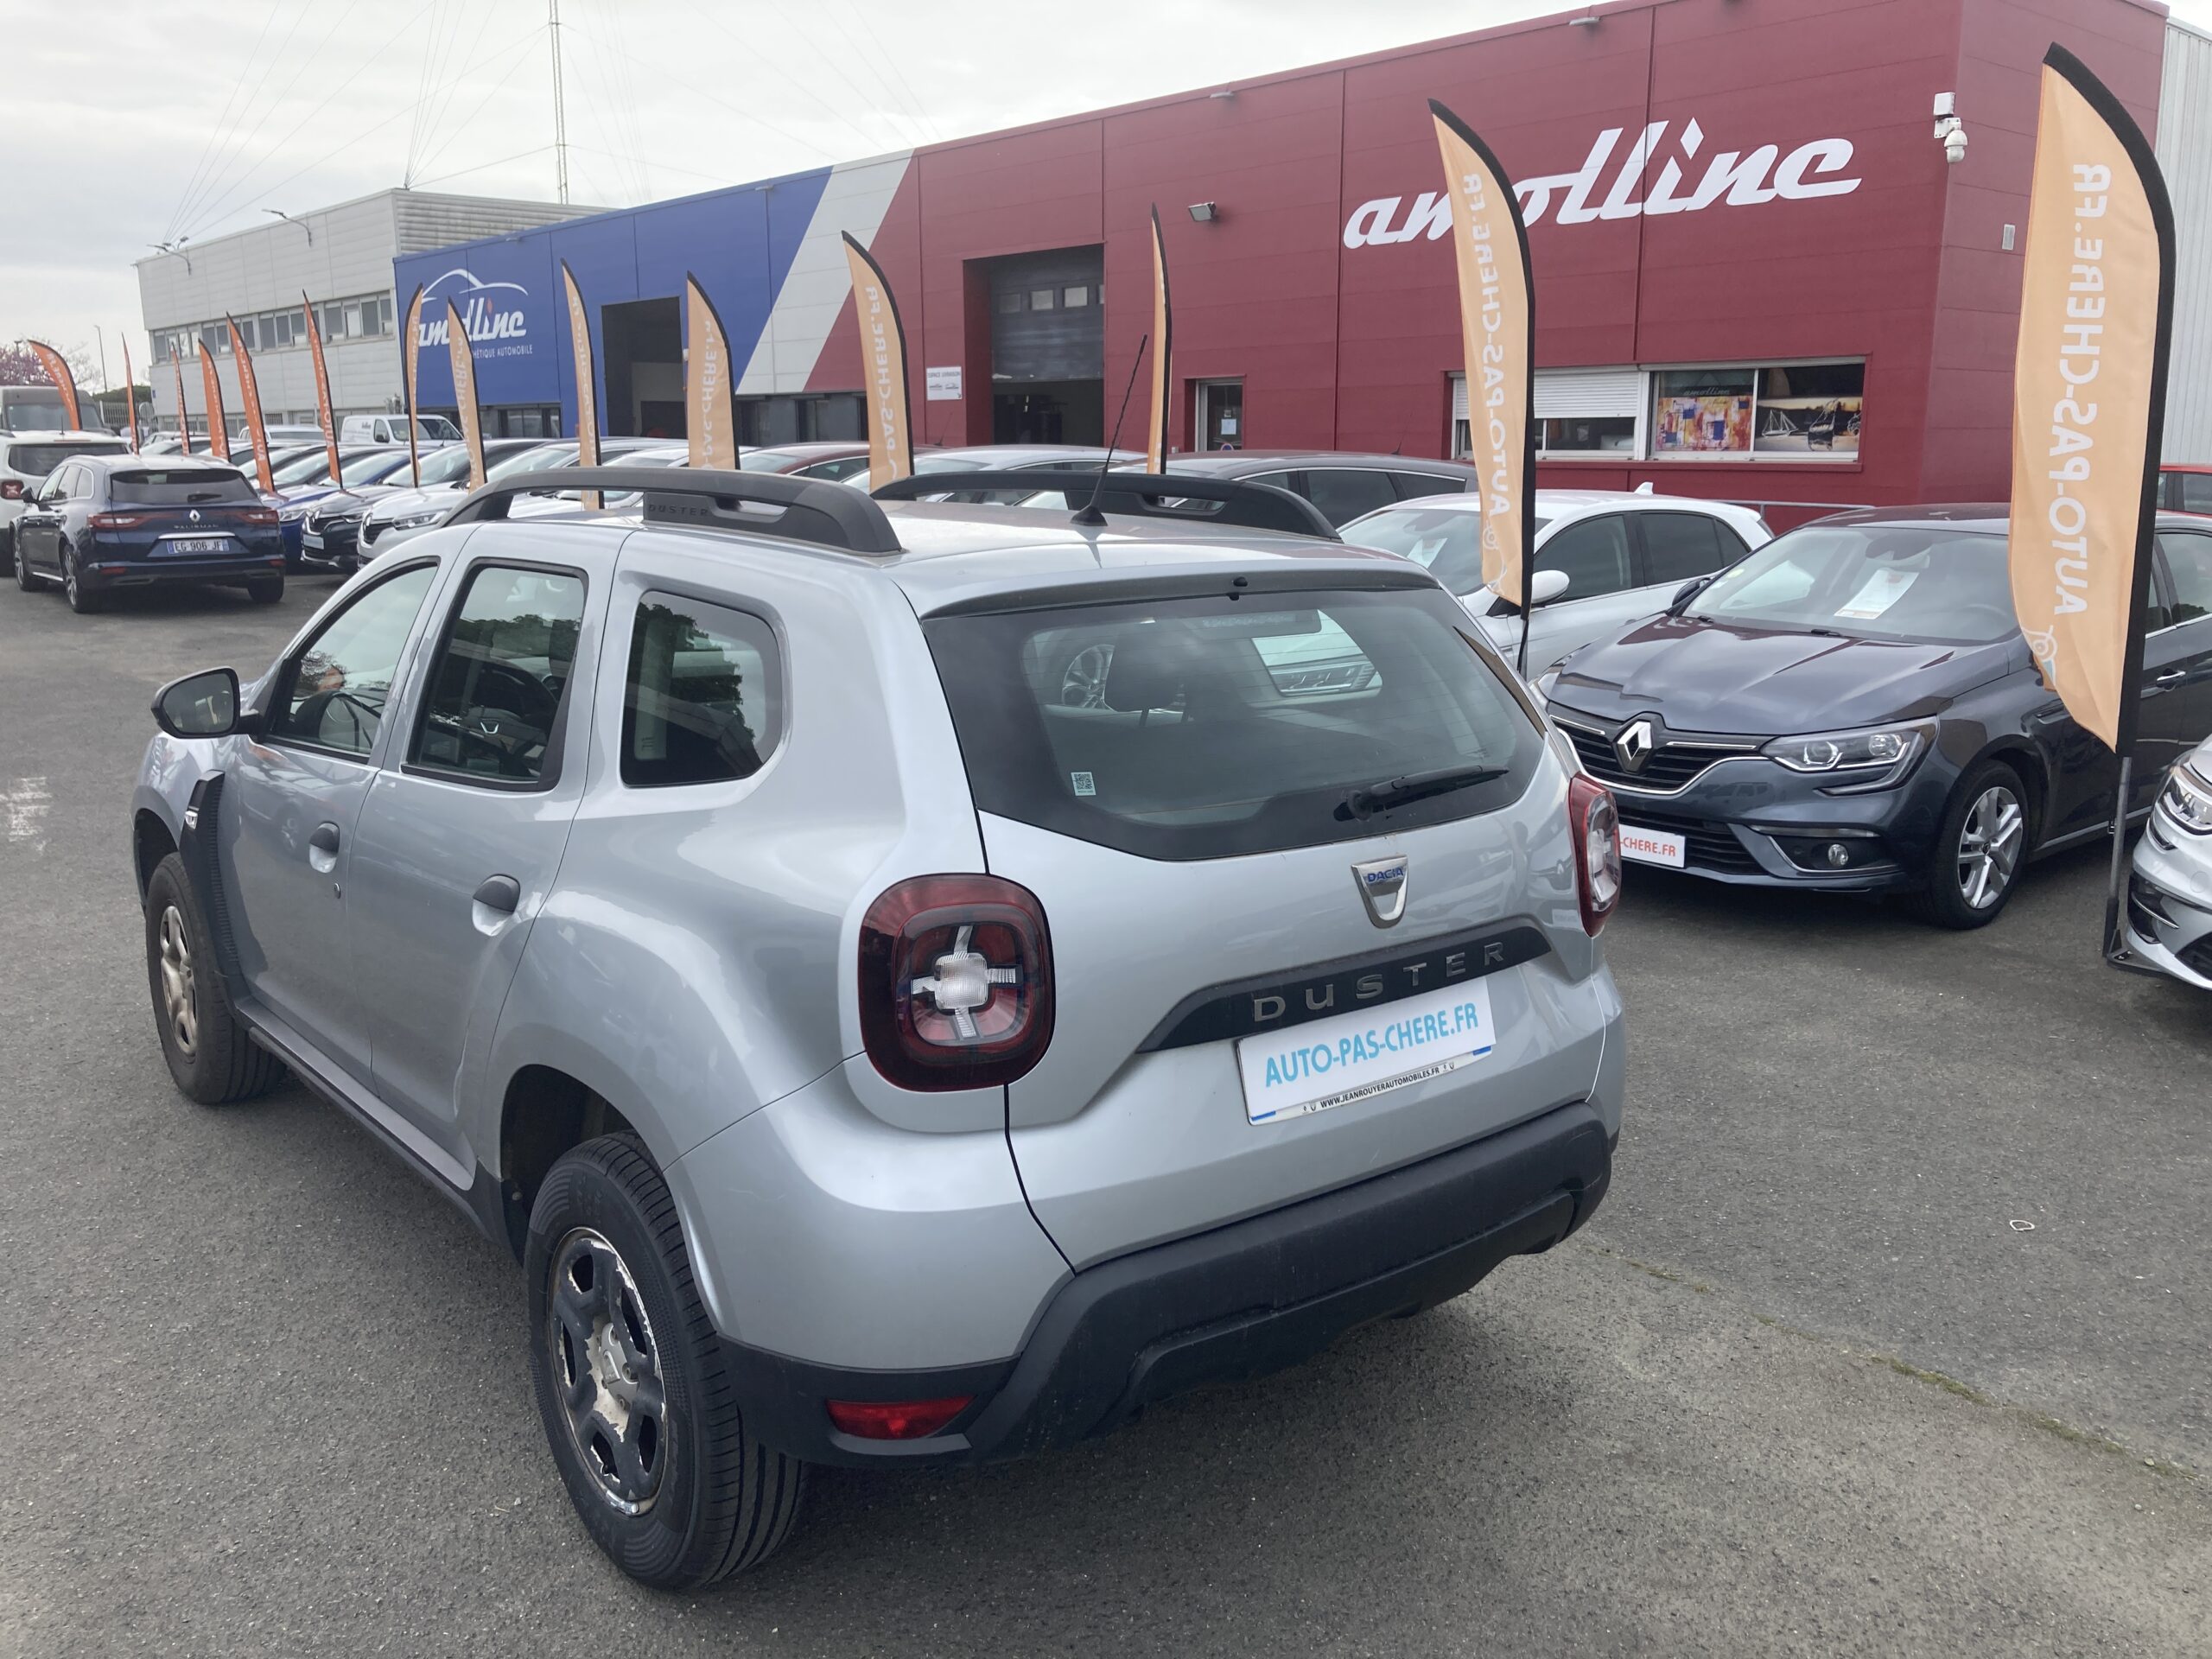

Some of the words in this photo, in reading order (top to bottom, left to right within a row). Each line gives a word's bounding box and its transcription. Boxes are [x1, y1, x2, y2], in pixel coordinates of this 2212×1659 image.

[497, 345, 533, 357] AUTOMOBILE
[649, 505, 709, 516] DUSTER
[1368, 866, 1404, 882] DACIA
[1254, 942, 1503, 1022] DUSTER
[1266, 1002, 1478, 1088] AUTO-PAS-CHERE.FR
[1320, 1066, 1440, 1109] WWW.JEANROUYERAUTOMOBILES.FR
